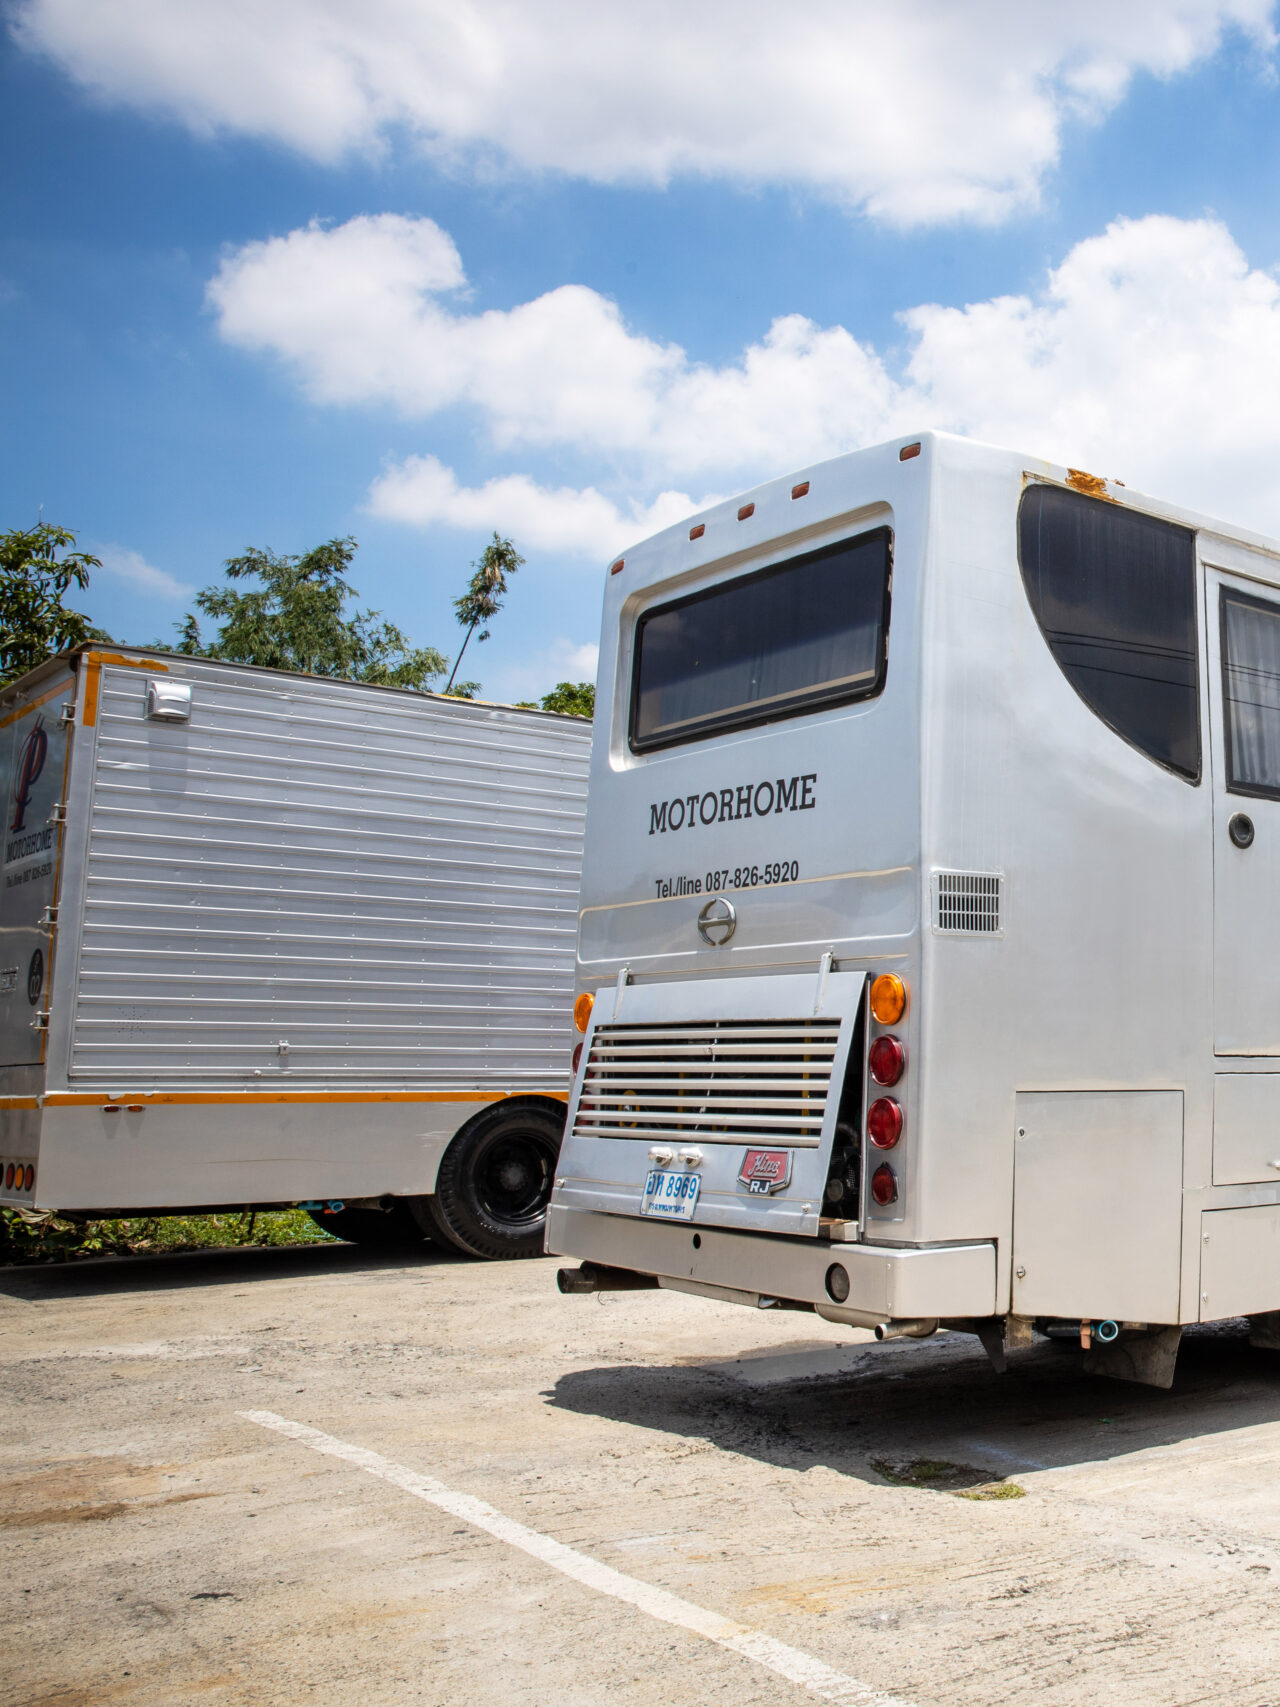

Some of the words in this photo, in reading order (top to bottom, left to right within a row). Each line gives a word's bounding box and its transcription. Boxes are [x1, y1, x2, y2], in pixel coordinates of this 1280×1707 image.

[648, 773, 817, 835] MOTORHOME
[5, 828, 53, 864] MOTORHOME
[655, 876, 701, 899] Tel./line
[705, 860, 799, 892] 087-826-5920
[666, 1175, 697, 1199] 8969
[750, 1180, 770, 1193] RJ
